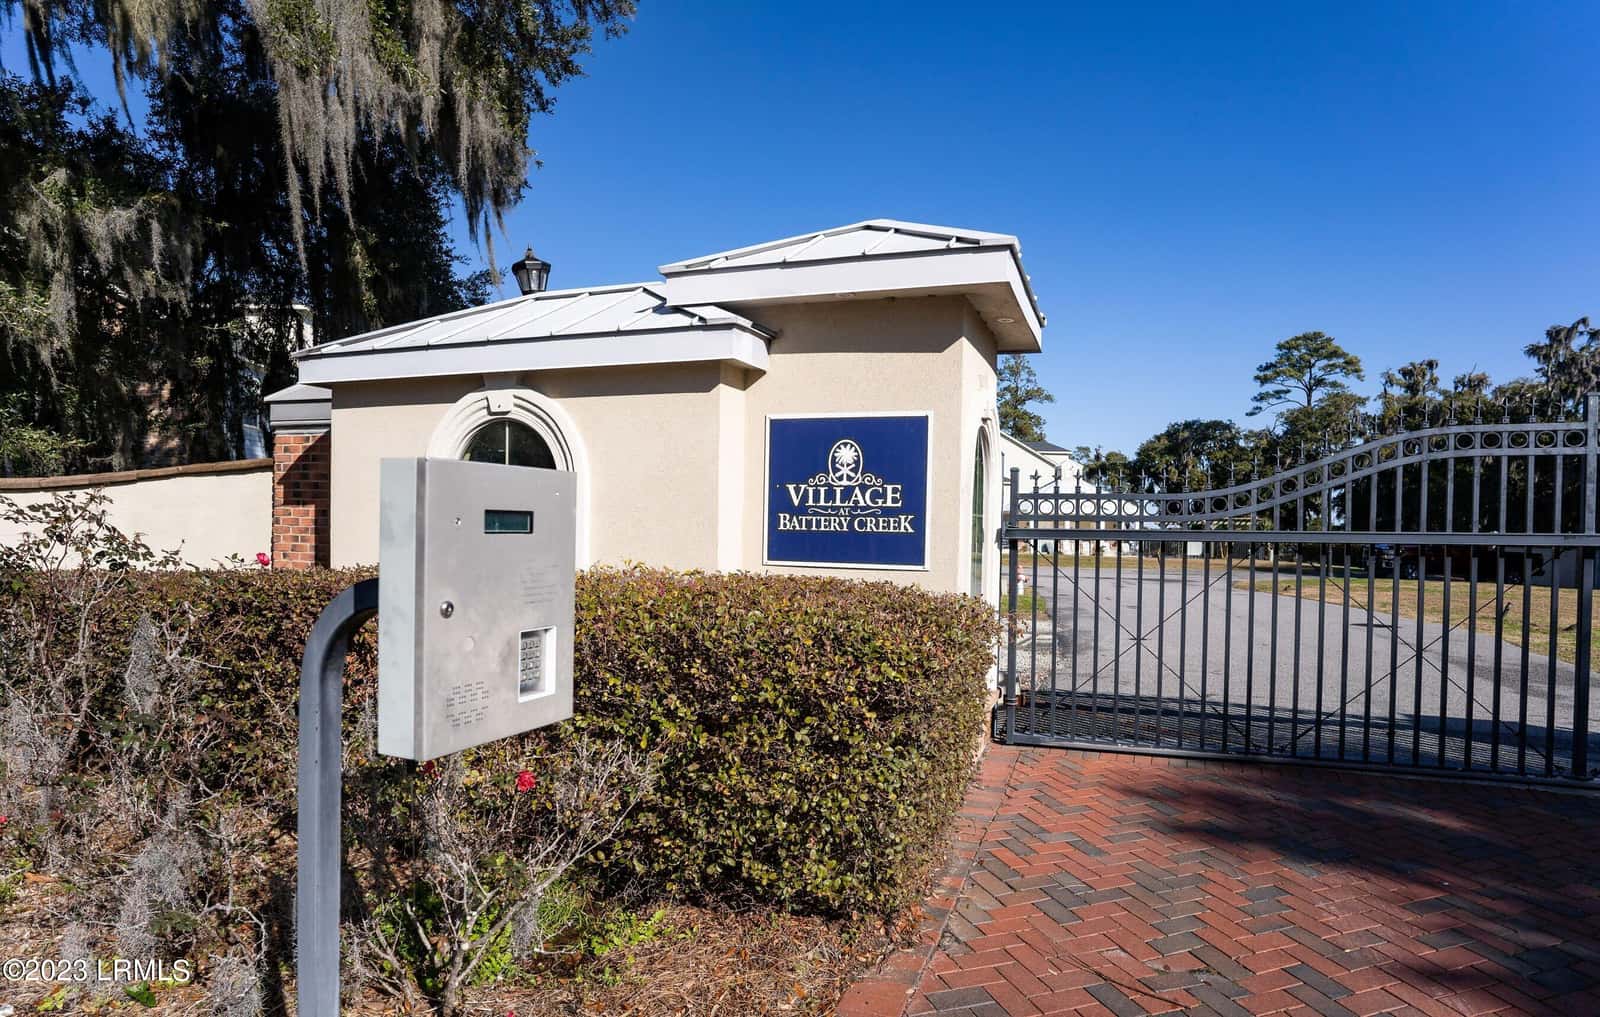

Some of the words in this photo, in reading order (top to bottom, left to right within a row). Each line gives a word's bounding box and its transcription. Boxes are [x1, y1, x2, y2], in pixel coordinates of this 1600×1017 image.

[786, 484, 902, 507] VILLAGE
[838, 507, 850, 516] AT
[778, 513, 851, 531] BATTERY
[854, 515, 915, 533] CREEK
